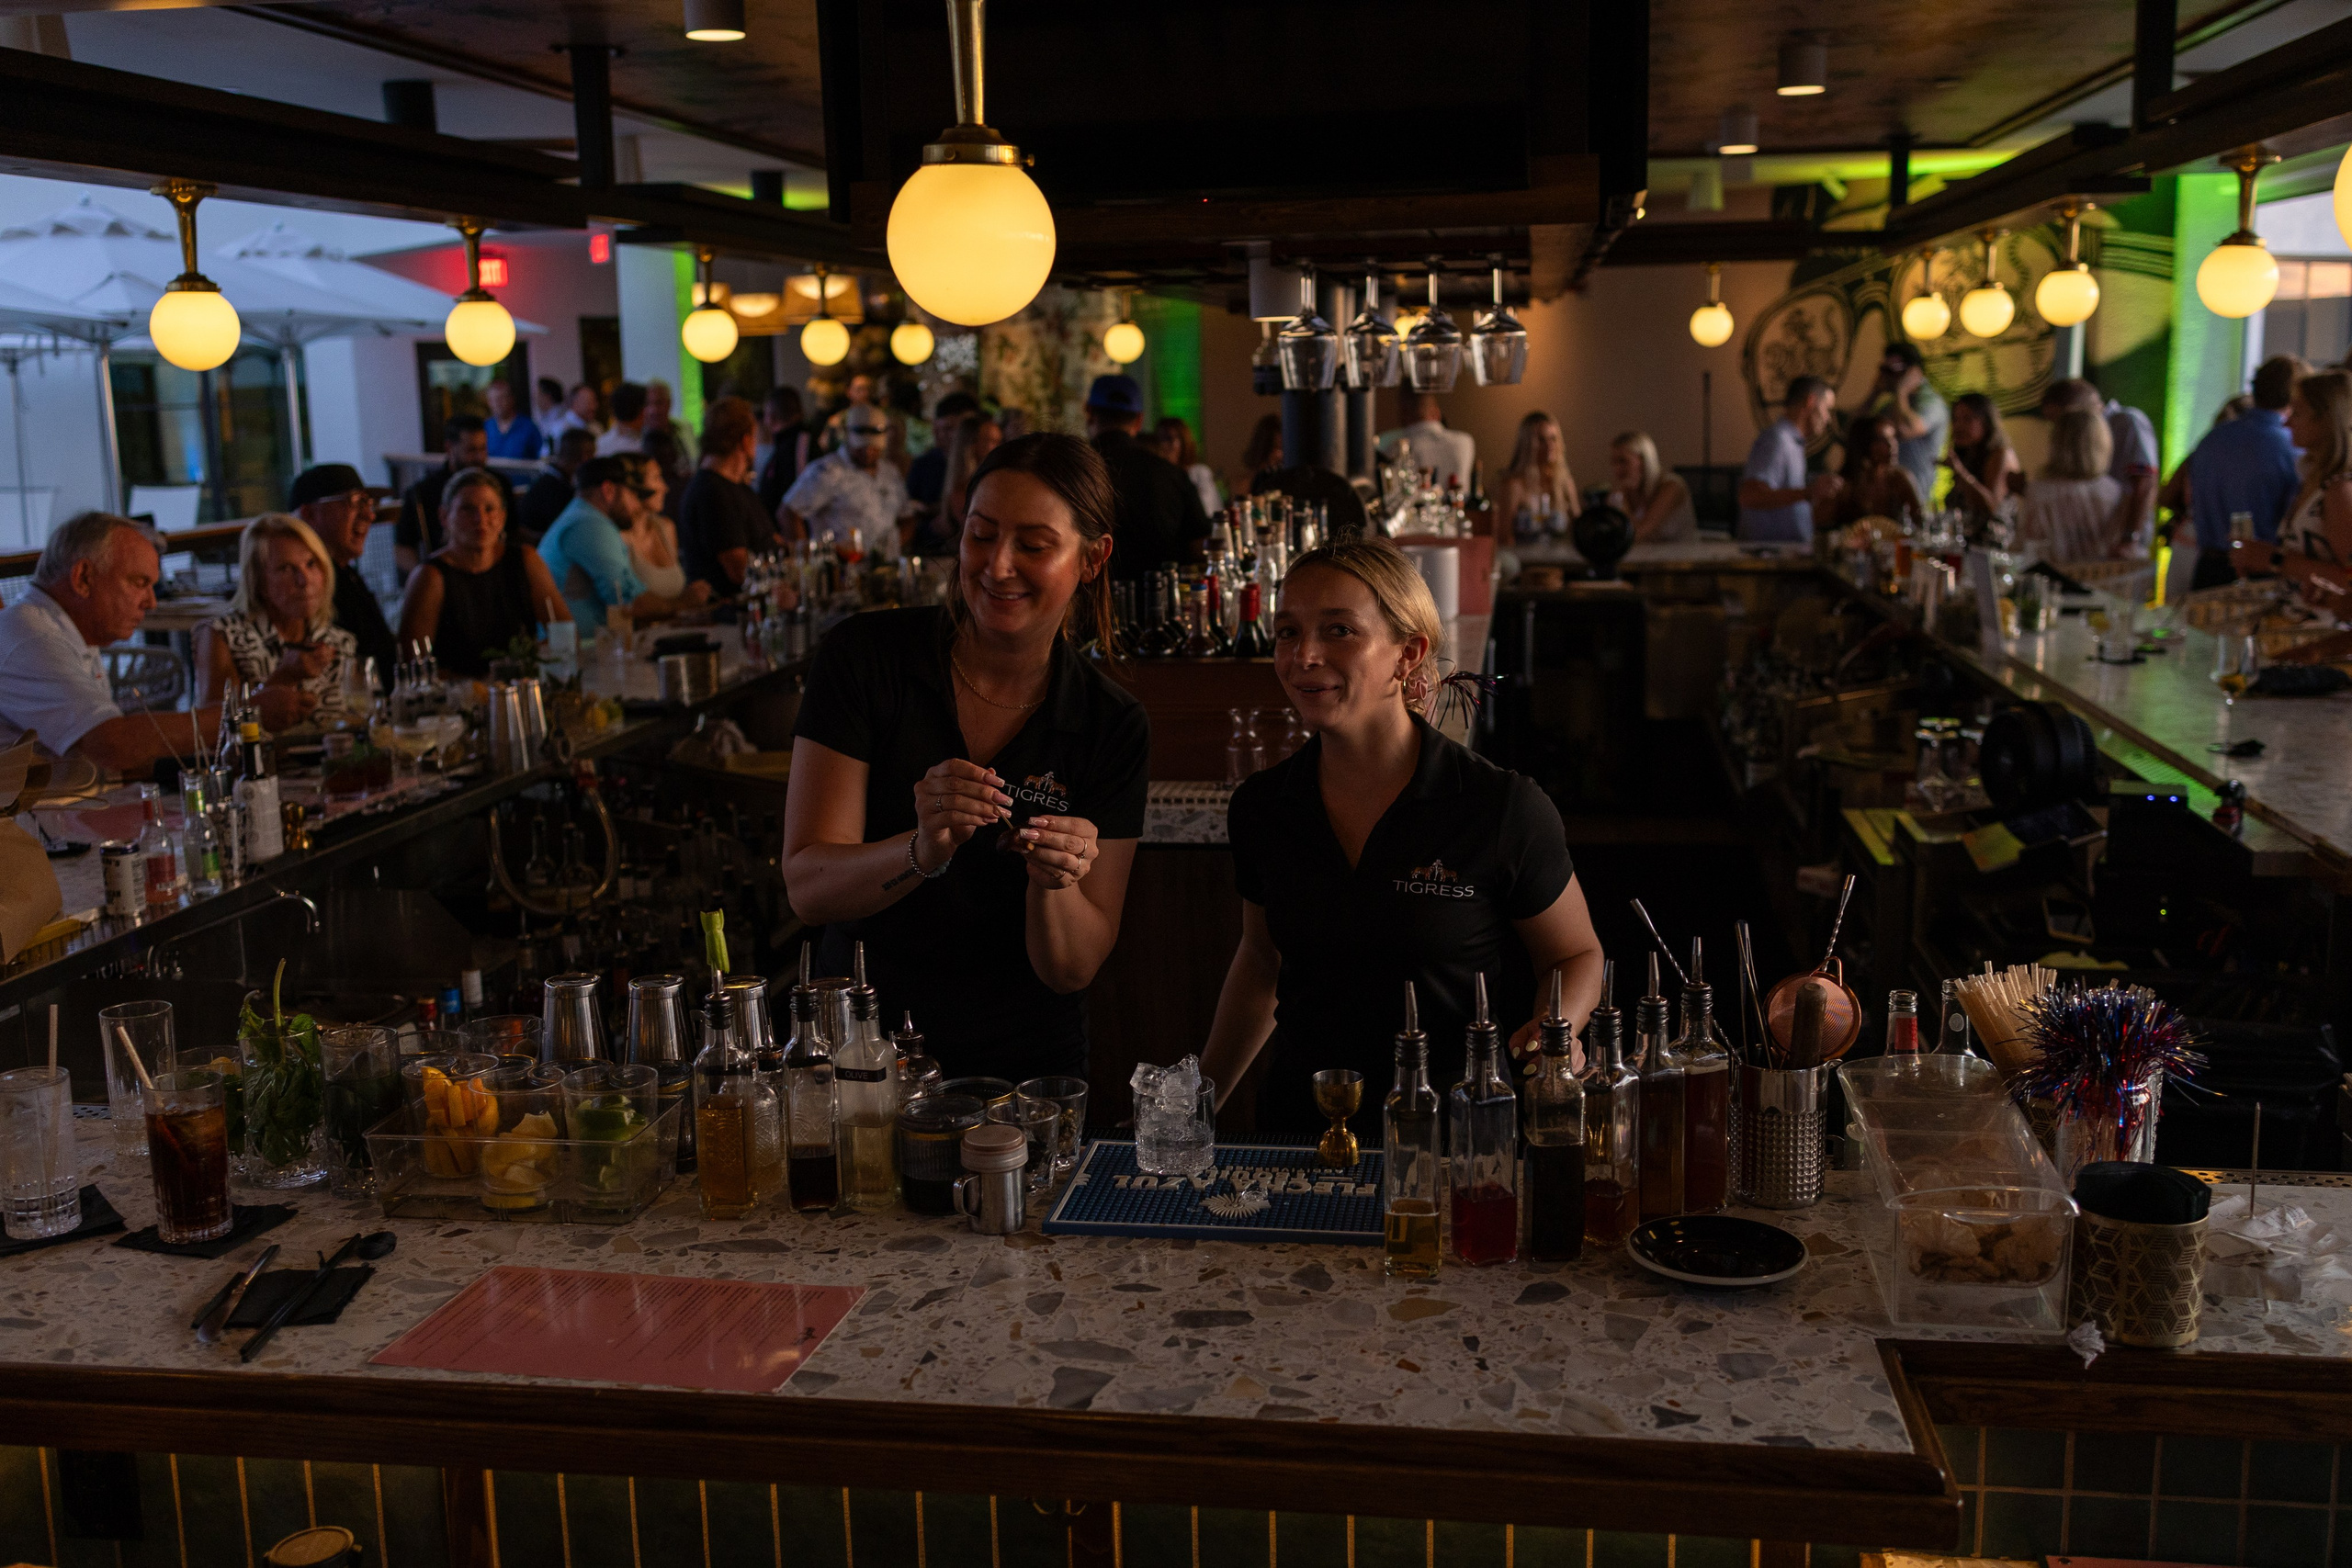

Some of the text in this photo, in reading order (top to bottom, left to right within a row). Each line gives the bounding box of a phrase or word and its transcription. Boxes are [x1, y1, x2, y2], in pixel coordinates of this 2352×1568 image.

[1392, 879, 1475, 898] TIGRESS
[844, 1070, 868, 1079] OLIVE
[1112, 1174, 1216, 1191] AZUL
